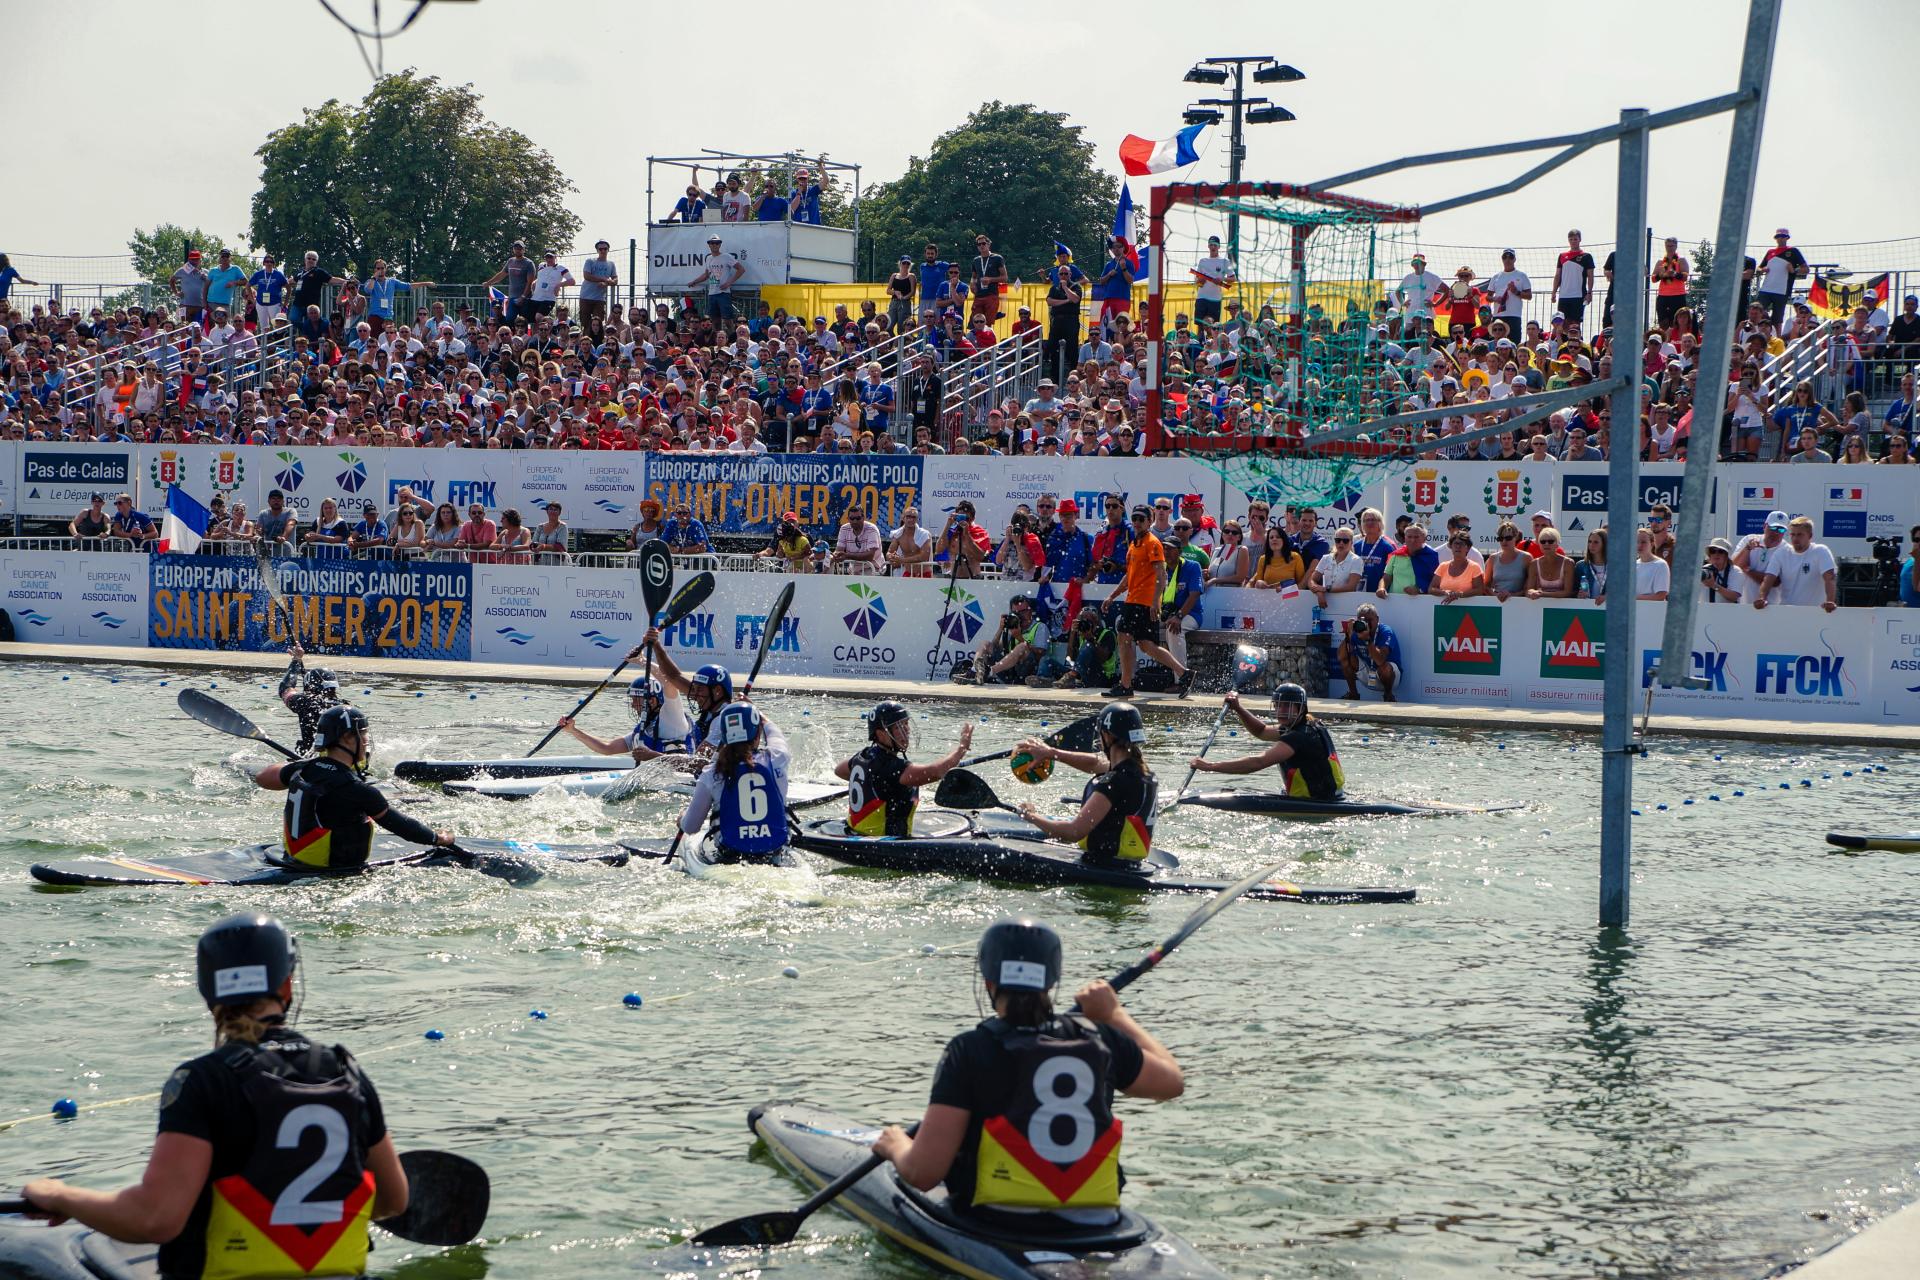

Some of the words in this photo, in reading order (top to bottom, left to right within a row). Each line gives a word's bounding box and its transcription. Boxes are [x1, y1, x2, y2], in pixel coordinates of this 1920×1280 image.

[654, 252, 738, 268] DILLIN
[27, 461, 125, 479] Pas-de-Calais
[526, 466, 564, 475] EUROPEAN
[589, 467, 629, 476] EUROPEAN
[650, 461, 717, 481] EUROPEAN
[721, 463, 830, 483] CHAMPIONSHIPS
[833, 464, 878, 484] CANOE
[883, 465, 919, 485] POLO
[532, 474, 557, 482] CANOE
[595, 475, 623, 483] CANOE
[937, 472, 980, 481] EUROPEAN
[1011, 473, 1054, 482] EUROPEAN
[521, 482, 568, 491] ASSOCIATION
[584, 484, 635, 493] ASSOCIATION
[944, 481, 972, 489] CANOE
[1018, 482, 1047, 490] CANOE
[50, 489, 64, 500] Le
[388, 479, 434, 505] FCK
[448, 480, 497, 508] FFCK
[932, 490, 985, 499] ASSOCIATION
[840, 485, 917, 527] 2017
[1868, 514, 1894, 522] CNDS
[12, 570, 57, 580] EUROPEAN
[87, 572, 131, 582] EUROPEAN
[20, 581, 49, 590] CANOE
[155, 565, 233, 589] EUROPEAN
[368, 572, 420, 596] CANOE
[426, 574, 467, 598] POLO
[94, 583, 123, 592] CANOE
[491, 585, 540, 596] EUROPEAN
[8, 590, 63, 600] ASSOCIATION
[82, 593, 137, 602] ASSOCIATION
[576, 588, 625, 599] EUROPEAN
[499, 597, 532, 607] CANOE
[584, 600, 617, 610] CANOE
[485, 607, 547, 618] ASSOCIATION
[569, 610, 633, 621] ASSOCIATION
[154, 589, 367, 647] SAINT-OMER
[377, 597, 464, 650] 2017
[1437, 636, 1499, 654] MAIF
[1545, 640, 1606, 658] MAIF
[833, 645, 896, 664] CAPSO
[716, 668, 726, 682] 3
[1755, 653, 1845, 697] FFCK
[1424, 685, 1467, 695] assureur
[1471, 686, 1508, 697] militant
[1530, 690, 1573, 700] assureur
[1577, 691, 1604, 701] milita
[340, 710, 352, 729] 1
[1103, 711, 1113, 730] 4
[848, 764, 866, 813] 6
[738, 772, 769, 822] 6
[288, 787, 304, 840] 1
[738, 823, 772, 839] FRA
[1027, 1055, 1097, 1165] 8
[269, 1103, 350, 1226] 2
